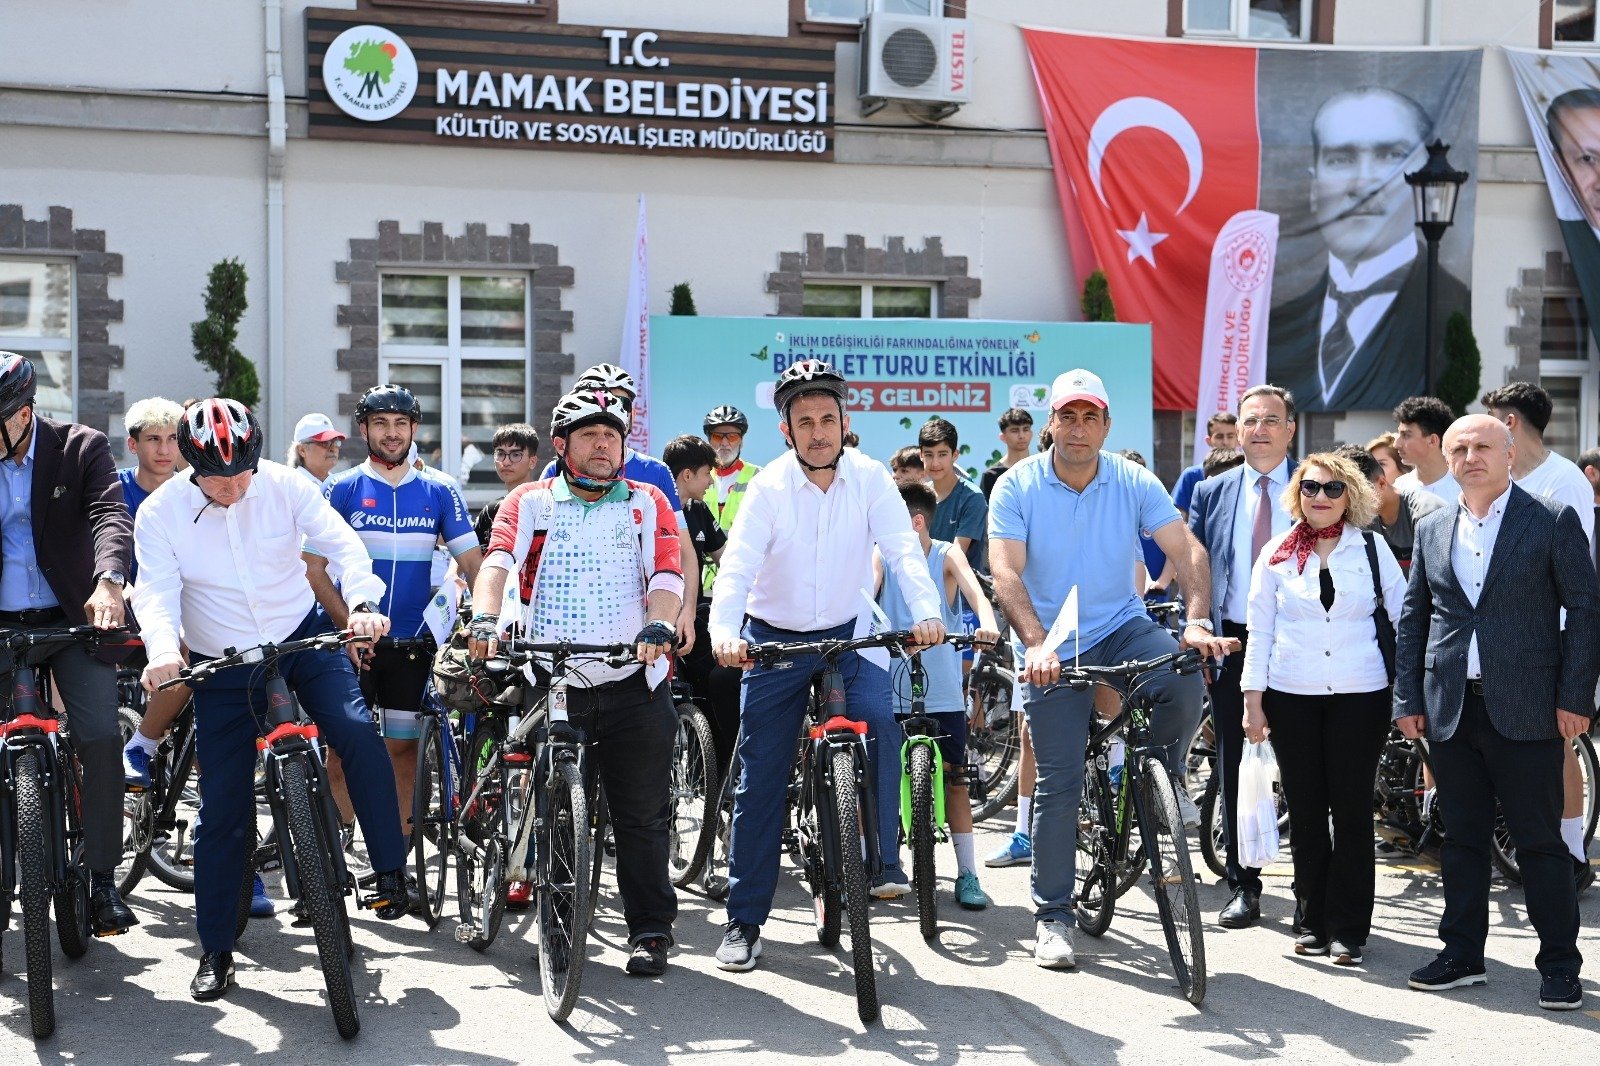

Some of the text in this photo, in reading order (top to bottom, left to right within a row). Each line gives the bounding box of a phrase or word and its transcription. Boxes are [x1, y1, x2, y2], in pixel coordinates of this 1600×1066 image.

[602, 29, 670, 67] T.C.
[950, 30, 966, 92] VESTEL
[343, 91, 371, 110] MAMAK
[436, 68, 828, 123] MAMAK BELEDİYESİ
[436, 113, 827, 154] KÜLTÜR VE SOSYAL İŞLER MÜDÜRLÜĞÜ
[789, 333, 1019, 351] İKLİM DEĞİŞİKLİĞİ FARKINDALIĞINA YÖNELİK
[872, 355, 928, 376] TURU
[934, 351, 1035, 377] ETKİNLİĞİ
[1217, 310, 1236, 412] EHİRCİLİK VE
[847, 383, 986, 411] OŞ GELDİNİZ
[365, 514, 435, 529] KOLUMAN
